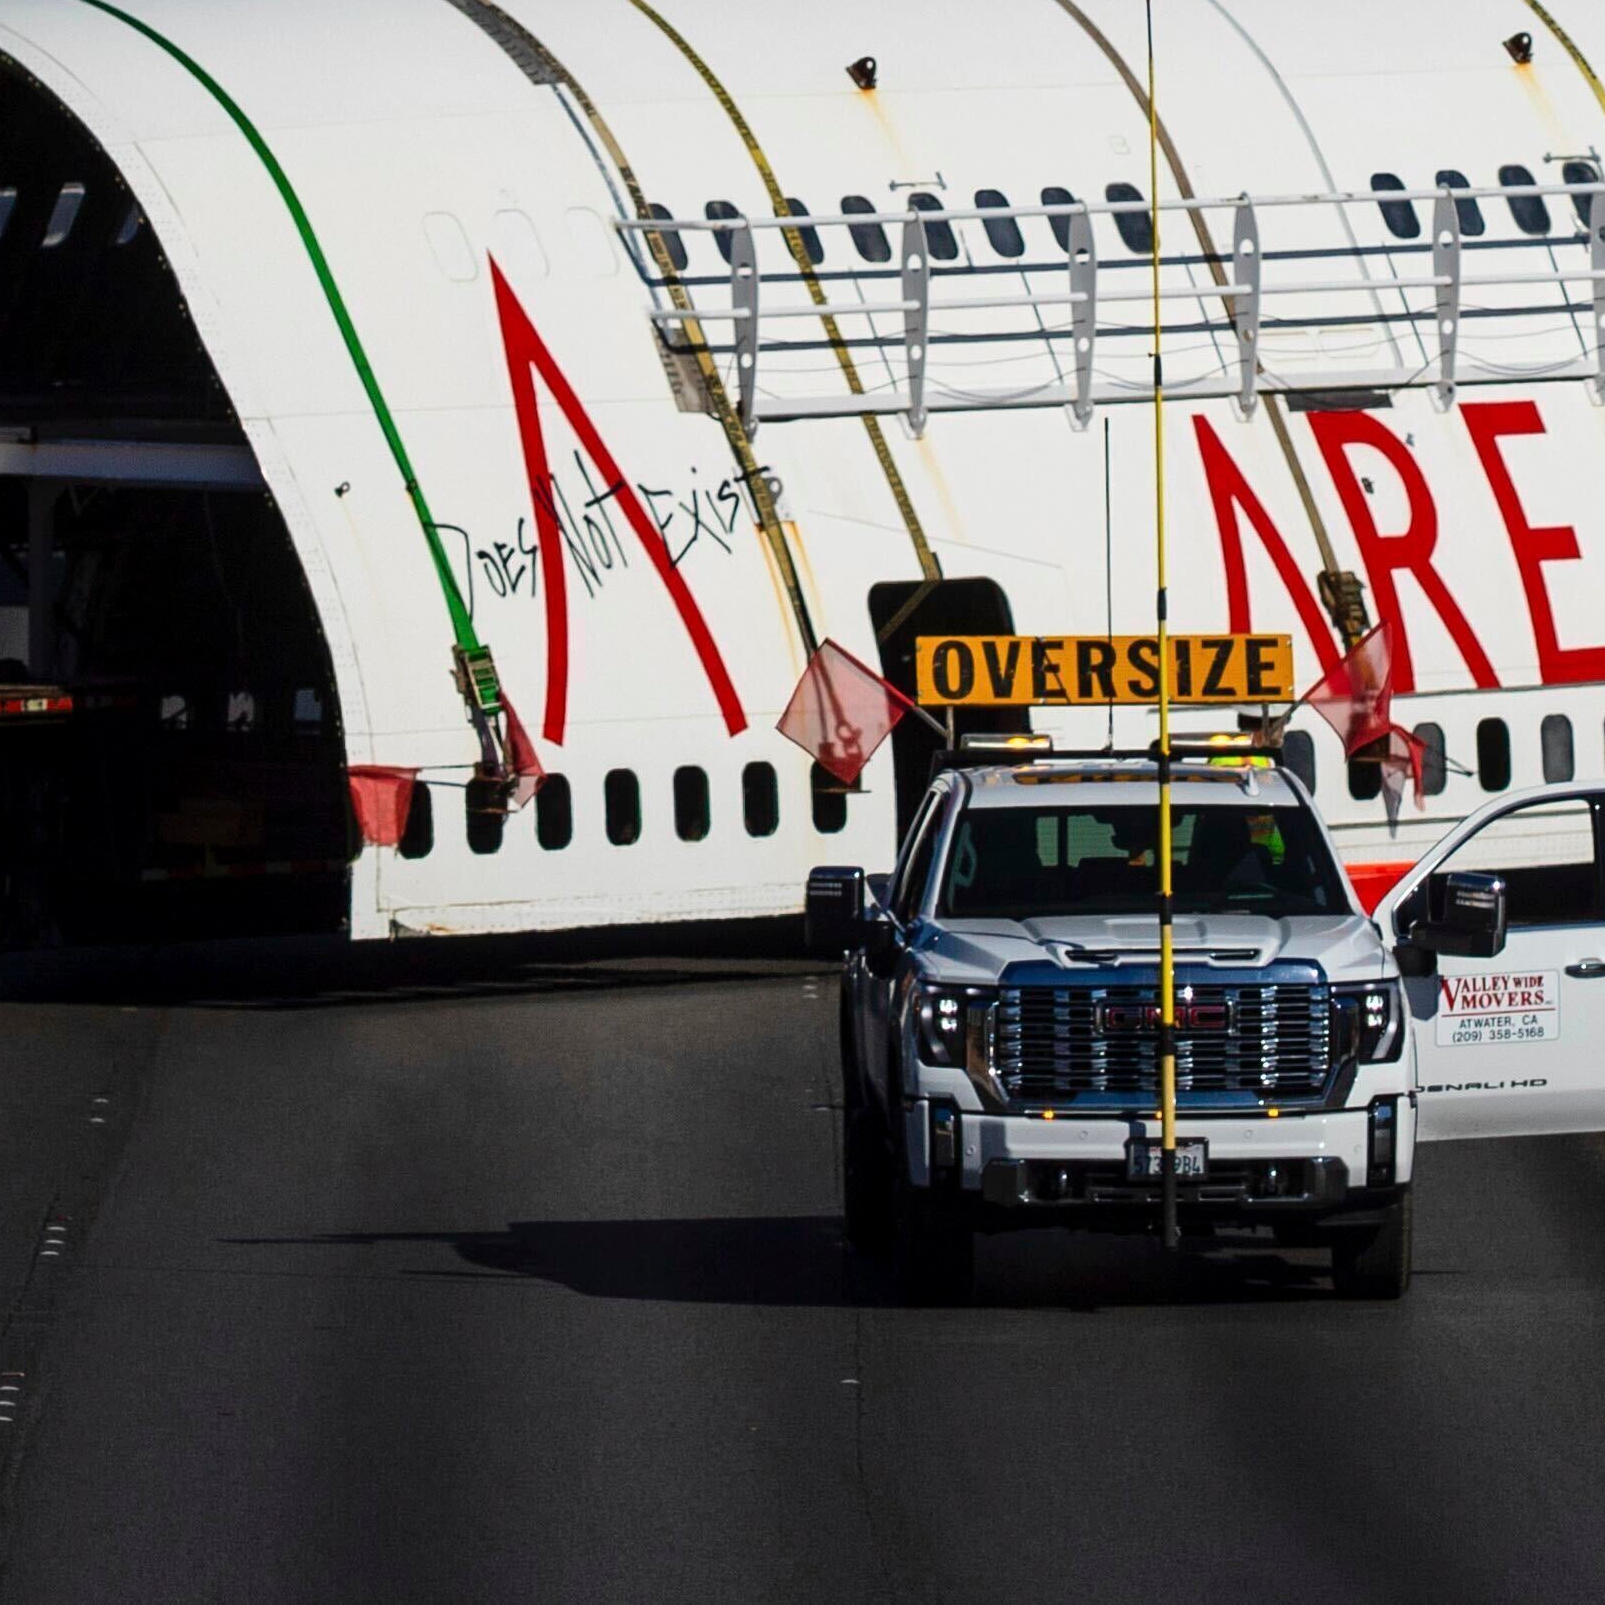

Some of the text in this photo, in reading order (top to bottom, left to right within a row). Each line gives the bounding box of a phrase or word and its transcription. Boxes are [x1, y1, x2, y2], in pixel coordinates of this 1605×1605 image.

[931, 637, 1283, 700] OVERSIZE
[1439, 975, 1544, 1012] VALLEY WIDE
[1460, 989, 1545, 1011] MOVERS
[1458, 1014, 1539, 1030] ATWATER, CA
[1451, 1026, 1545, 1043] (209) 358-5168
[1510, 1078, 1548, 1088] HD
[1134, 1154, 1203, 1176] 5739B4
